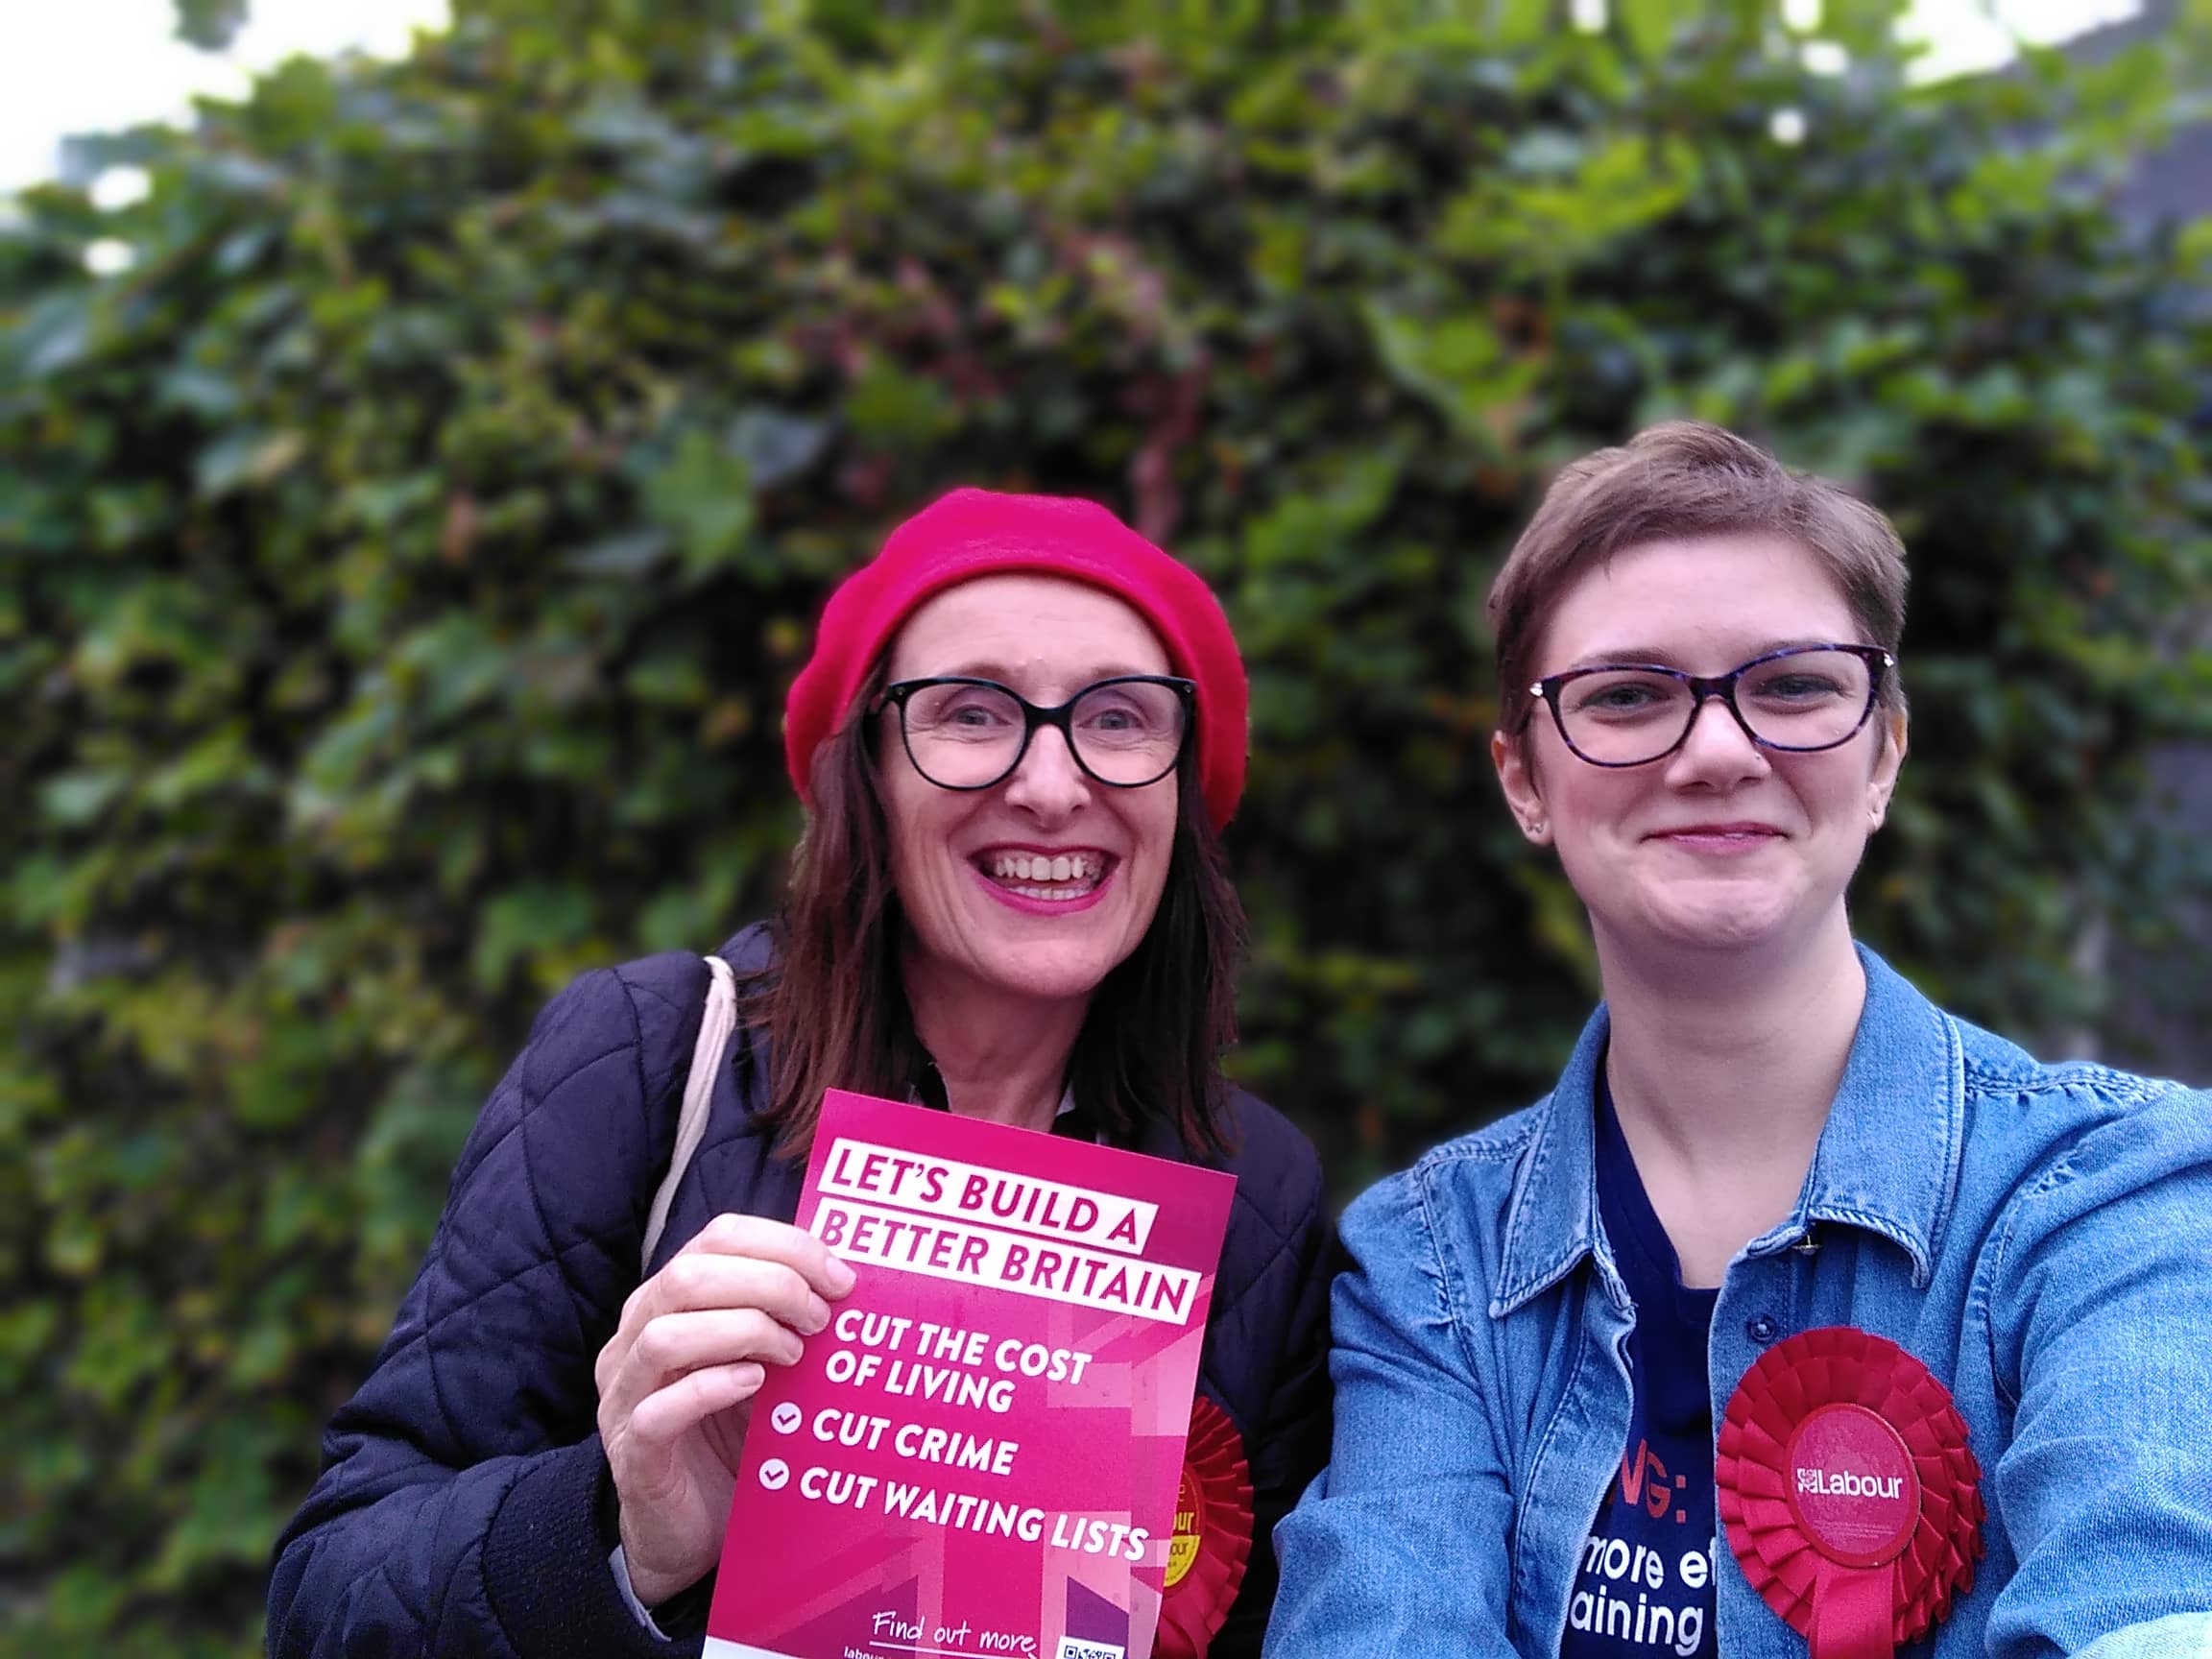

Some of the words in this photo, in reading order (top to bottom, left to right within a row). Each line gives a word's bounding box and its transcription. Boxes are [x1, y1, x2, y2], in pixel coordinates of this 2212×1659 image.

[831, 1148, 950, 1203] LET'S
[958, 1174, 1098, 1233] BUILD
[1106, 1208, 1138, 1245] A
[820, 1209, 989, 1275] BETTER
[999, 1244, 1190, 1314] BRITAIN
[825, 1350, 882, 1387] OF
[884, 1359, 1016, 1413] LIVING
[834, 1309, 912, 1351] CUT
[917, 1323, 991, 1367] THE
[994, 1338, 1093, 1385] COST
[812, 1408, 891, 1451] CUT
[894, 1424, 1020, 1476] CRIME
[799, 1466, 878, 1509] CUT
[882, 1480, 1046, 1543] WAITING
[1050, 1513, 1150, 1562] LISTS
[1817, 1469, 1904, 1500] Labour
[872, 1610, 926, 1641] Find
[933, 1620, 972, 1647] out
[978, 1630, 1038, 1653] more
